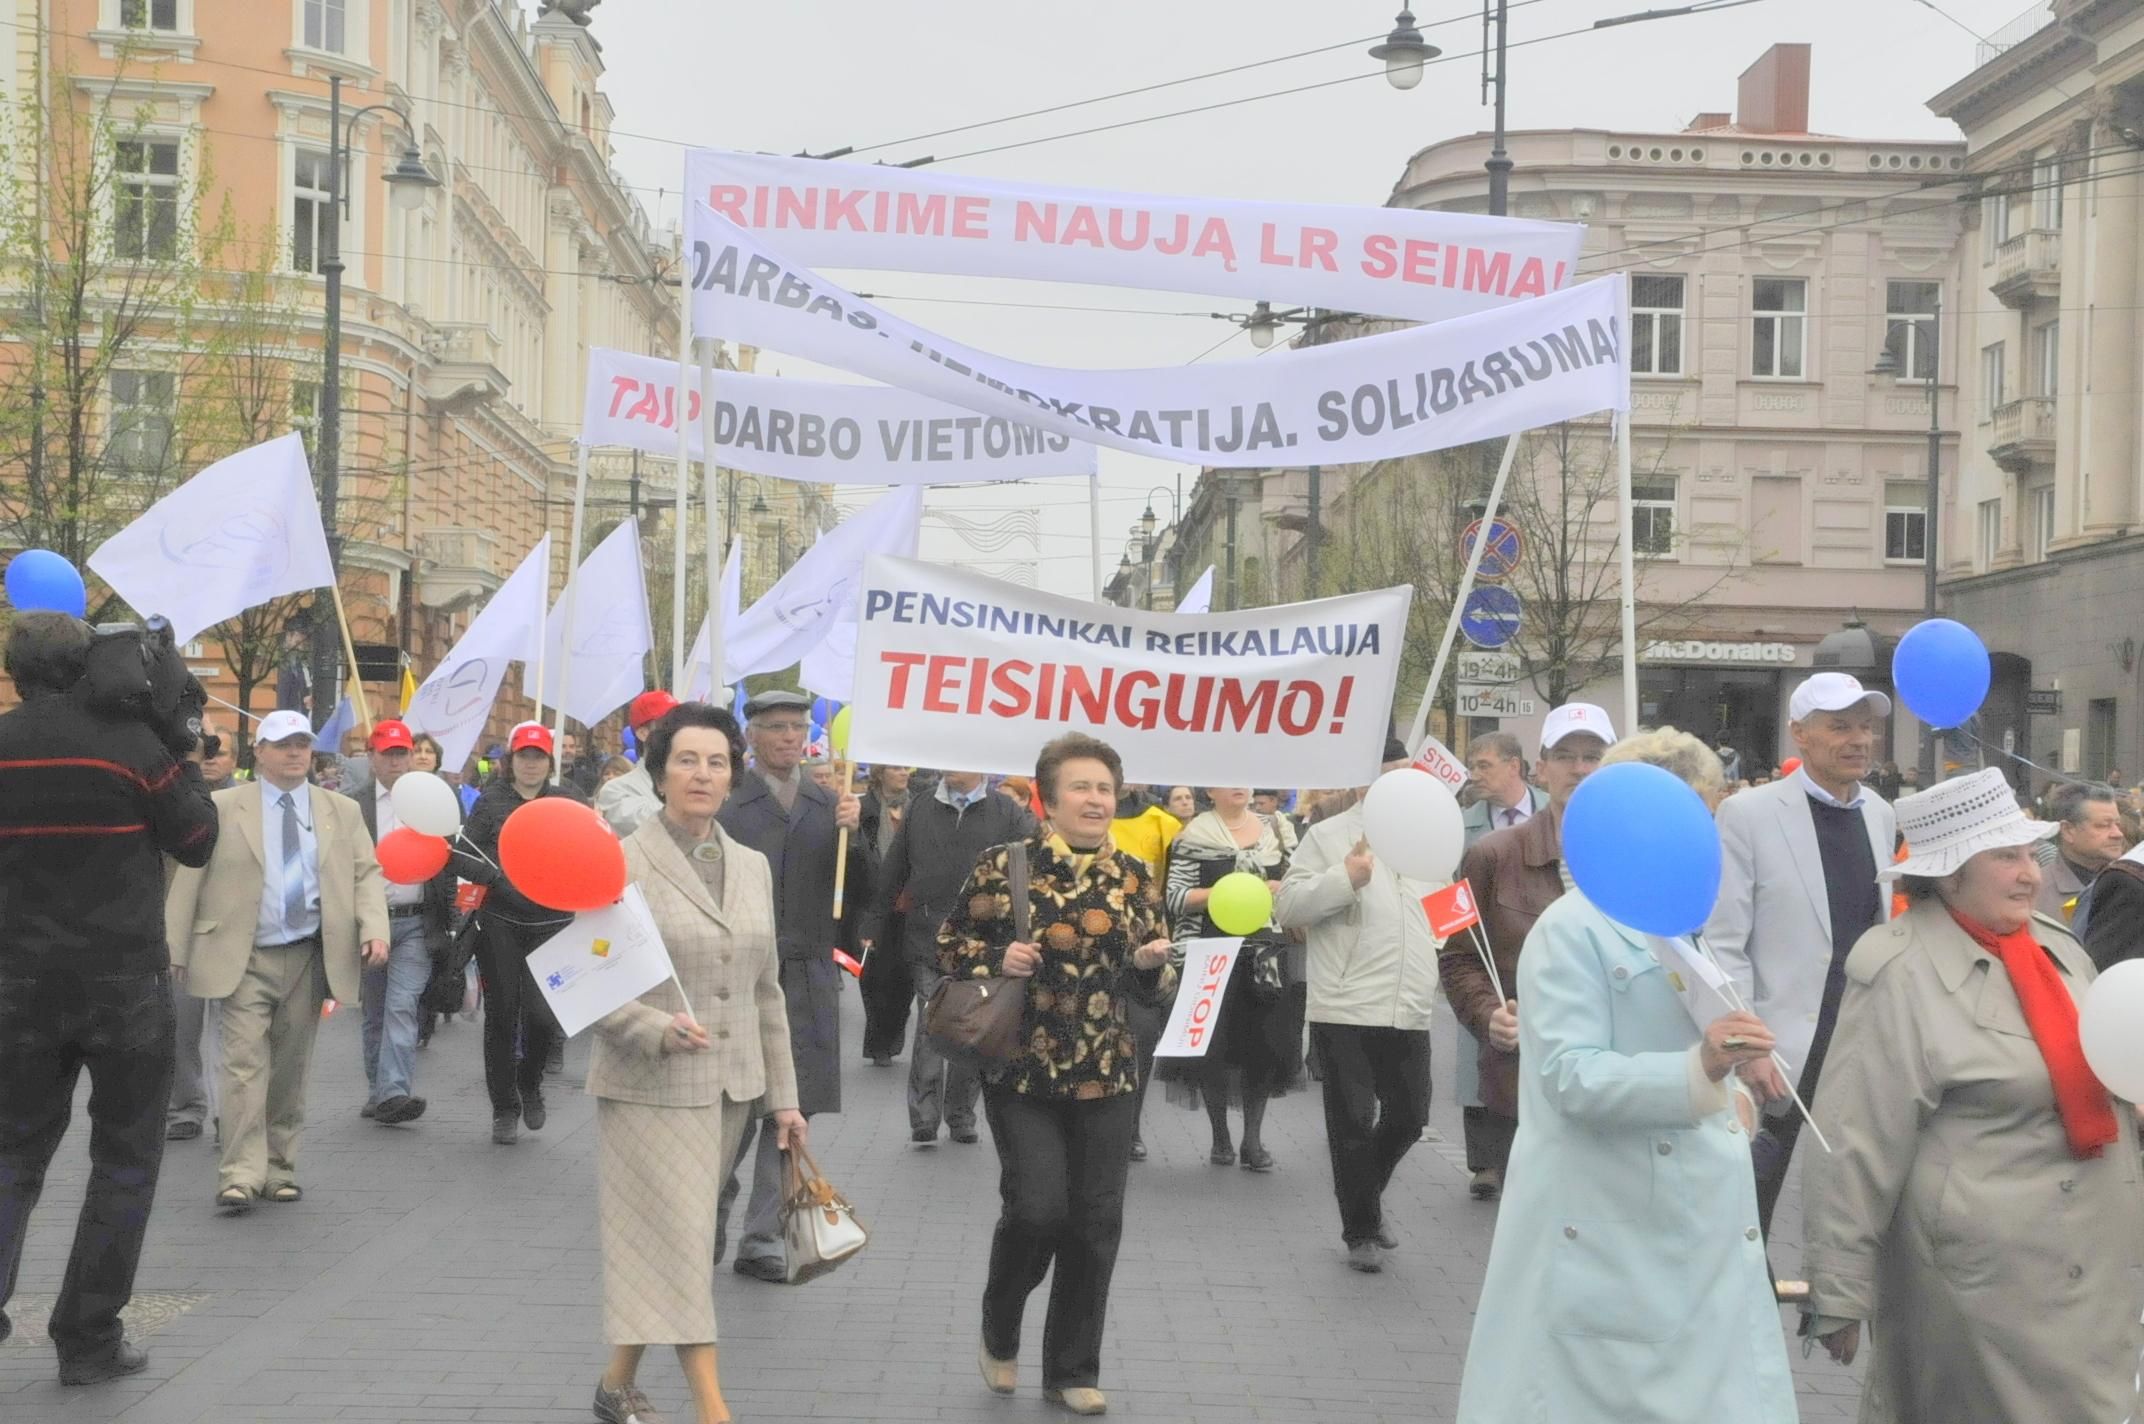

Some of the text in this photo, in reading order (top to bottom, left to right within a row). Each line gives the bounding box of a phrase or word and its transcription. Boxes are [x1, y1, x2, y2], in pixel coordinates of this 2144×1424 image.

[709, 184, 990, 240] RINKIME
[1014, 200, 1238, 273] NAUJĄ
[1259, 222, 1339, 273] LR
[713, 400, 862, 461] DARBO
[865, 589, 1381, 657] PENSININKAI REIKALAUJA
[880, 650, 1355, 737] TEISINGUMO!
[1522, 702, 1532, 713] 15
[1423, 747, 1462, 784] STOP
[1188, 954, 1229, 1048] STOP
